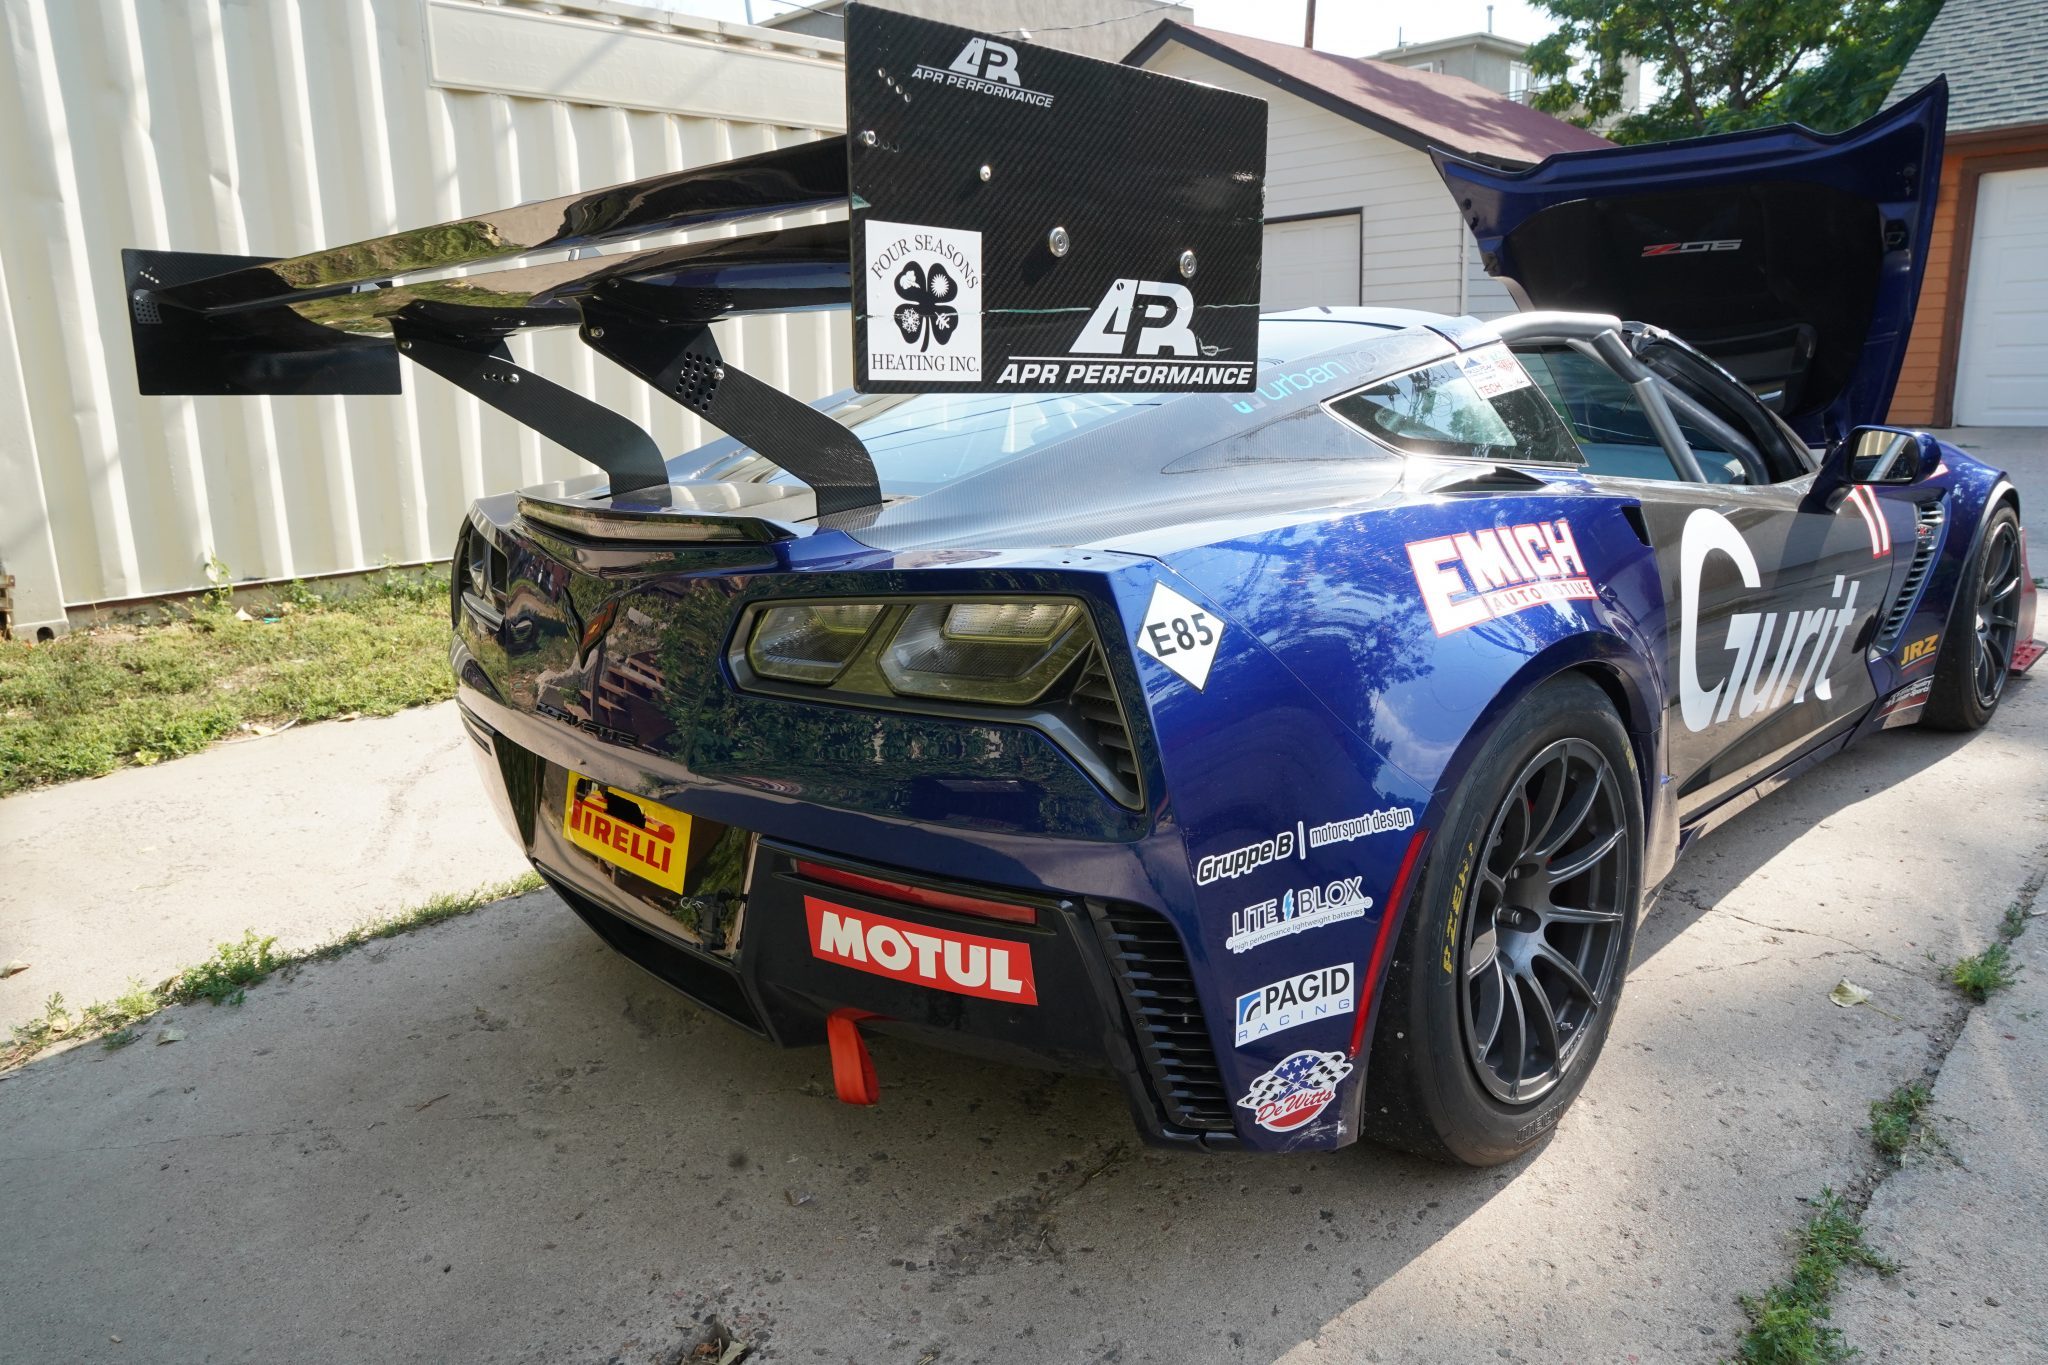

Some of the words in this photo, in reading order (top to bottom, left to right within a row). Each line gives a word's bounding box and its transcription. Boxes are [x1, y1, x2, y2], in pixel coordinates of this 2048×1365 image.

[911, 68, 944, 84] APR
[946, 75, 1054, 108] PERFORMANCE
[870, 238, 912, 280] FOUR
[914, 234, 979, 289] SEASONS
[871, 353, 945, 371] HEATING
[950, 356, 979, 372] INC.
[996, 363, 1060, 384] APR
[1065, 364, 1253, 386] PERFORMANCE
[1405, 519, 1588, 638] EMICH
[1492, 580, 1592, 612] AUTOOTIVE
[1146, 612, 1214, 658] E85
[1900, 633, 1939, 666] JRZ
[1311, 816, 1371, 846] motorsport
[1373, 808, 1412, 830] design
[1199, 843, 1272, 883] Gruppe
[1277, 833, 1293, 857] B
[1233, 900, 1277, 936] LITE
[1299, 879, 1363, 915] BLOX
[819, 910, 1023, 994] MOTUL
[1234, 940, 1249, 952] high
[1250, 927, 1291, 947] performance
[1292, 915, 1331, 932] lightweight
[1332, 908, 1363, 921] batteries
[1265, 967, 1350, 1015] PAGID
[1238, 998, 1350, 1042] RACING
